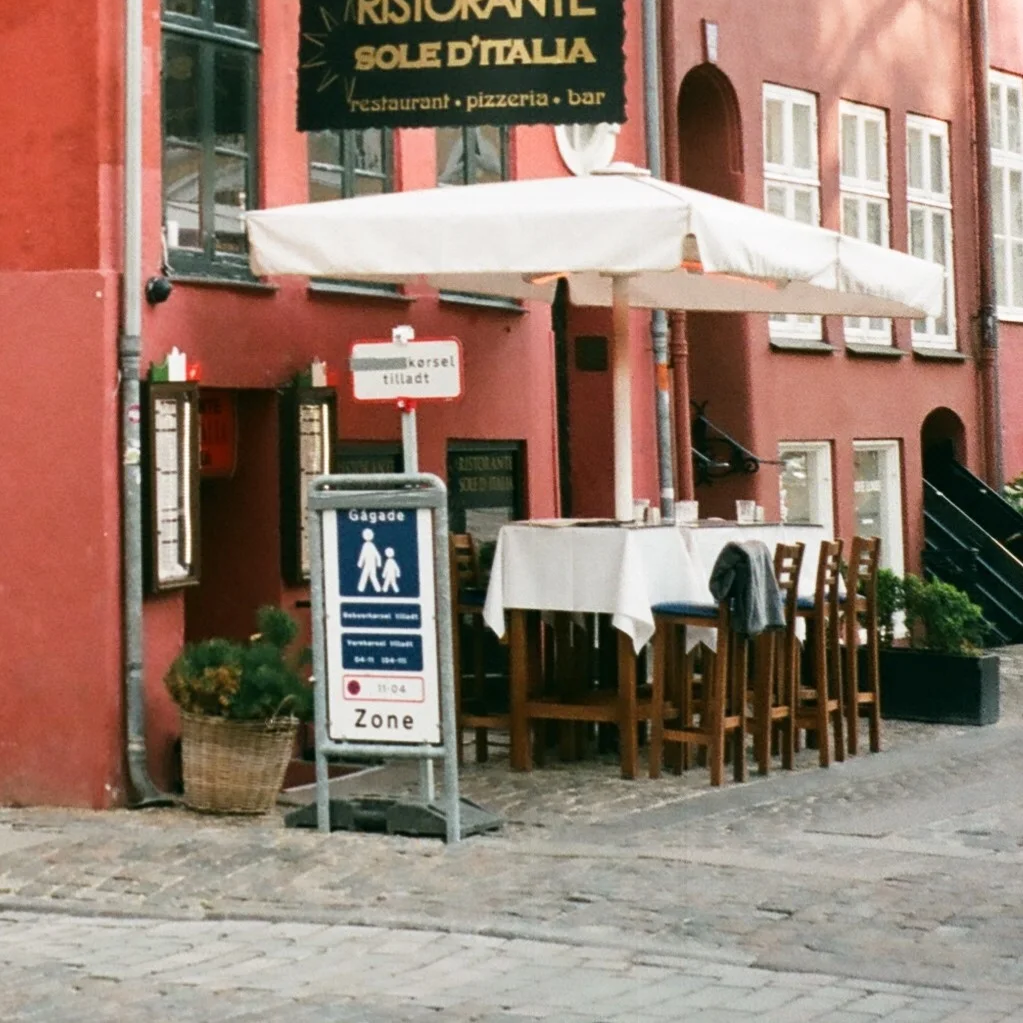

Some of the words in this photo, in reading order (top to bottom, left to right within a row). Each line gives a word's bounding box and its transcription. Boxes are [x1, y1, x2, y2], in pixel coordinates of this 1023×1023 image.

[354, 41, 442, 72] SOLE
[447, 34, 597, 67] D'ITALIA
[350, 95, 450, 113] restaurant
[466, 90, 549, 113] pizzeria
[567, 88, 606, 106] bar
[383, 373, 430, 385] tilladt
[354, 708, 414, 730] Zone
